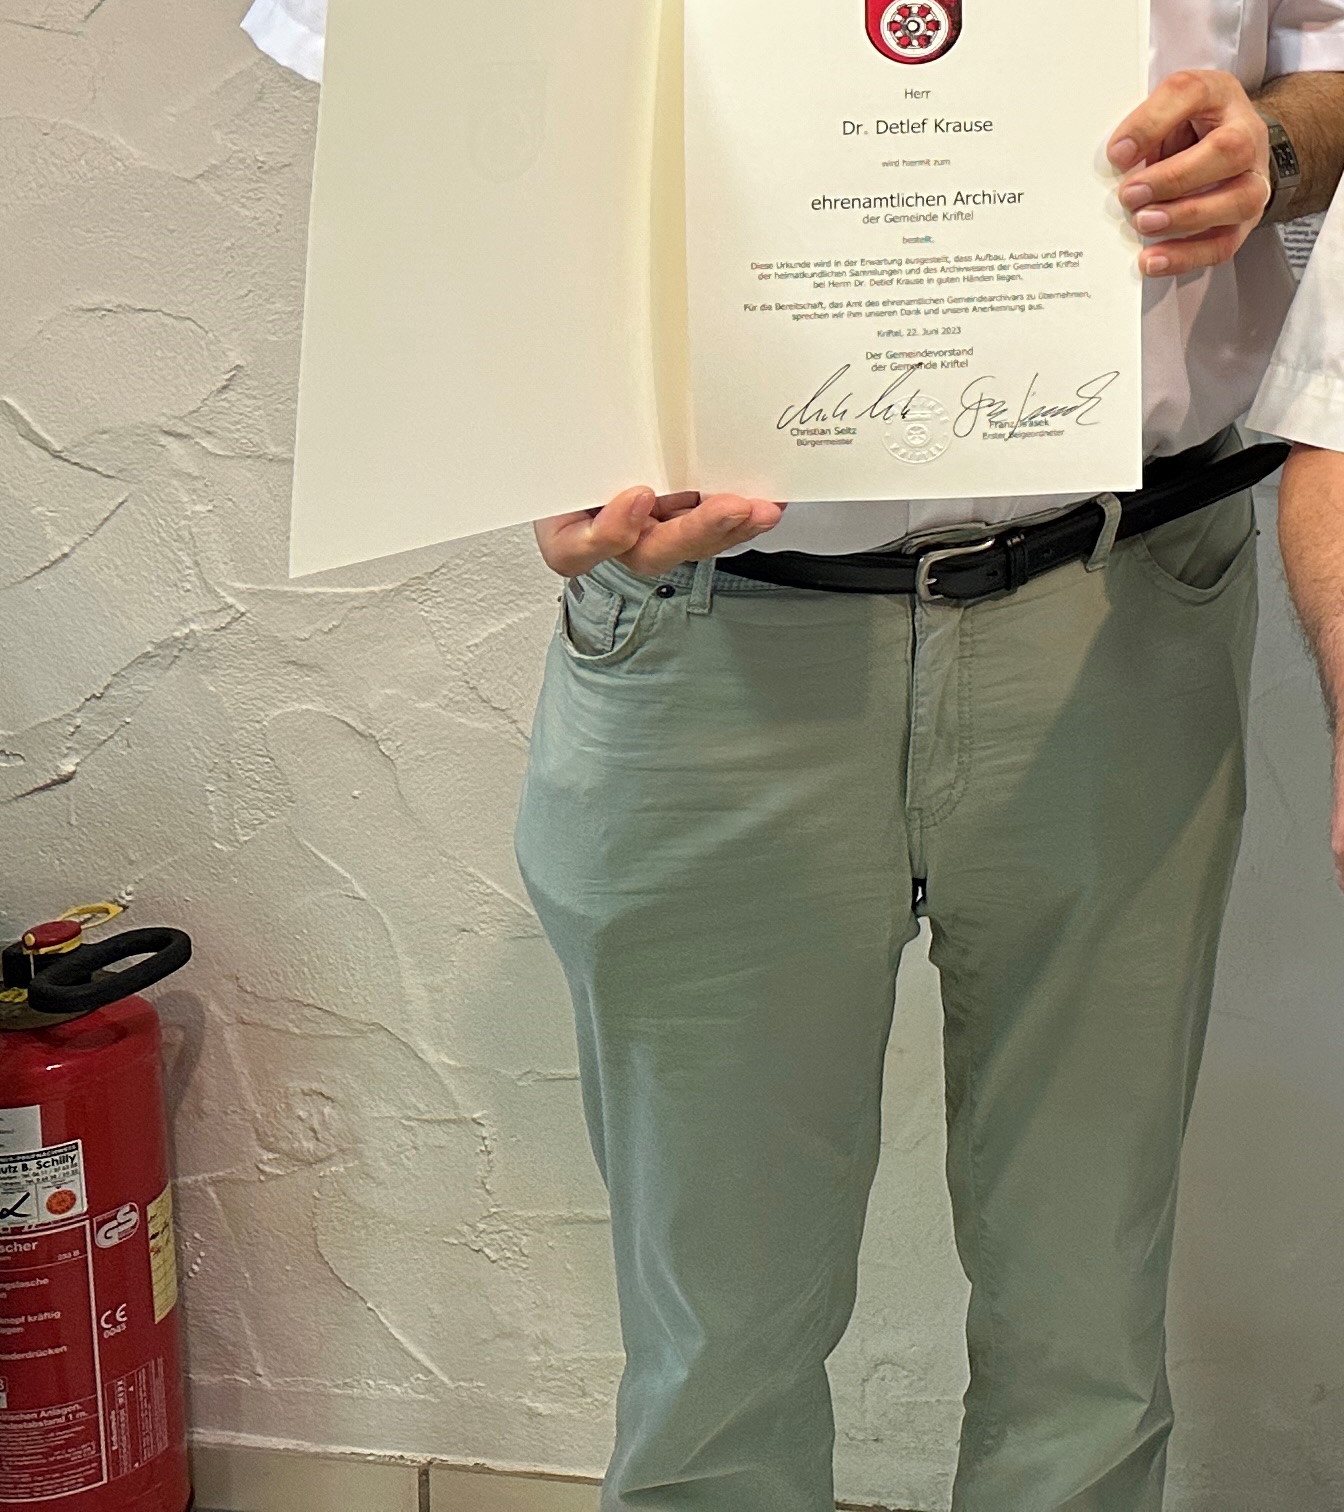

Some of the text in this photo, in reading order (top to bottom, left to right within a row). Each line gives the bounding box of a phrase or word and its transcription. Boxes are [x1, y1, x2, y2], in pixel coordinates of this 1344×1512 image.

[904, 89, 931, 99] Herr
[843, 118, 993, 135] Dr. Detlef Krause
[811, 190, 1024, 210] ehrenamtlichen Archivar
[862, 211, 973, 224] der Gemeinde Kriftel
[866, 347, 973, 360] Der Gemeindevorstand
[890, 361, 937, 371] Gemeinde
[941, 359, 968, 368] Kriftel
[790, 427, 857, 436] Christian Seitz
[22, 1163, 32, 1172] B.
[36, 1154, 76, 1169] Schilly
[97, 1204, 139, 1245] GS
[100, 1303, 128, 1329] CE
